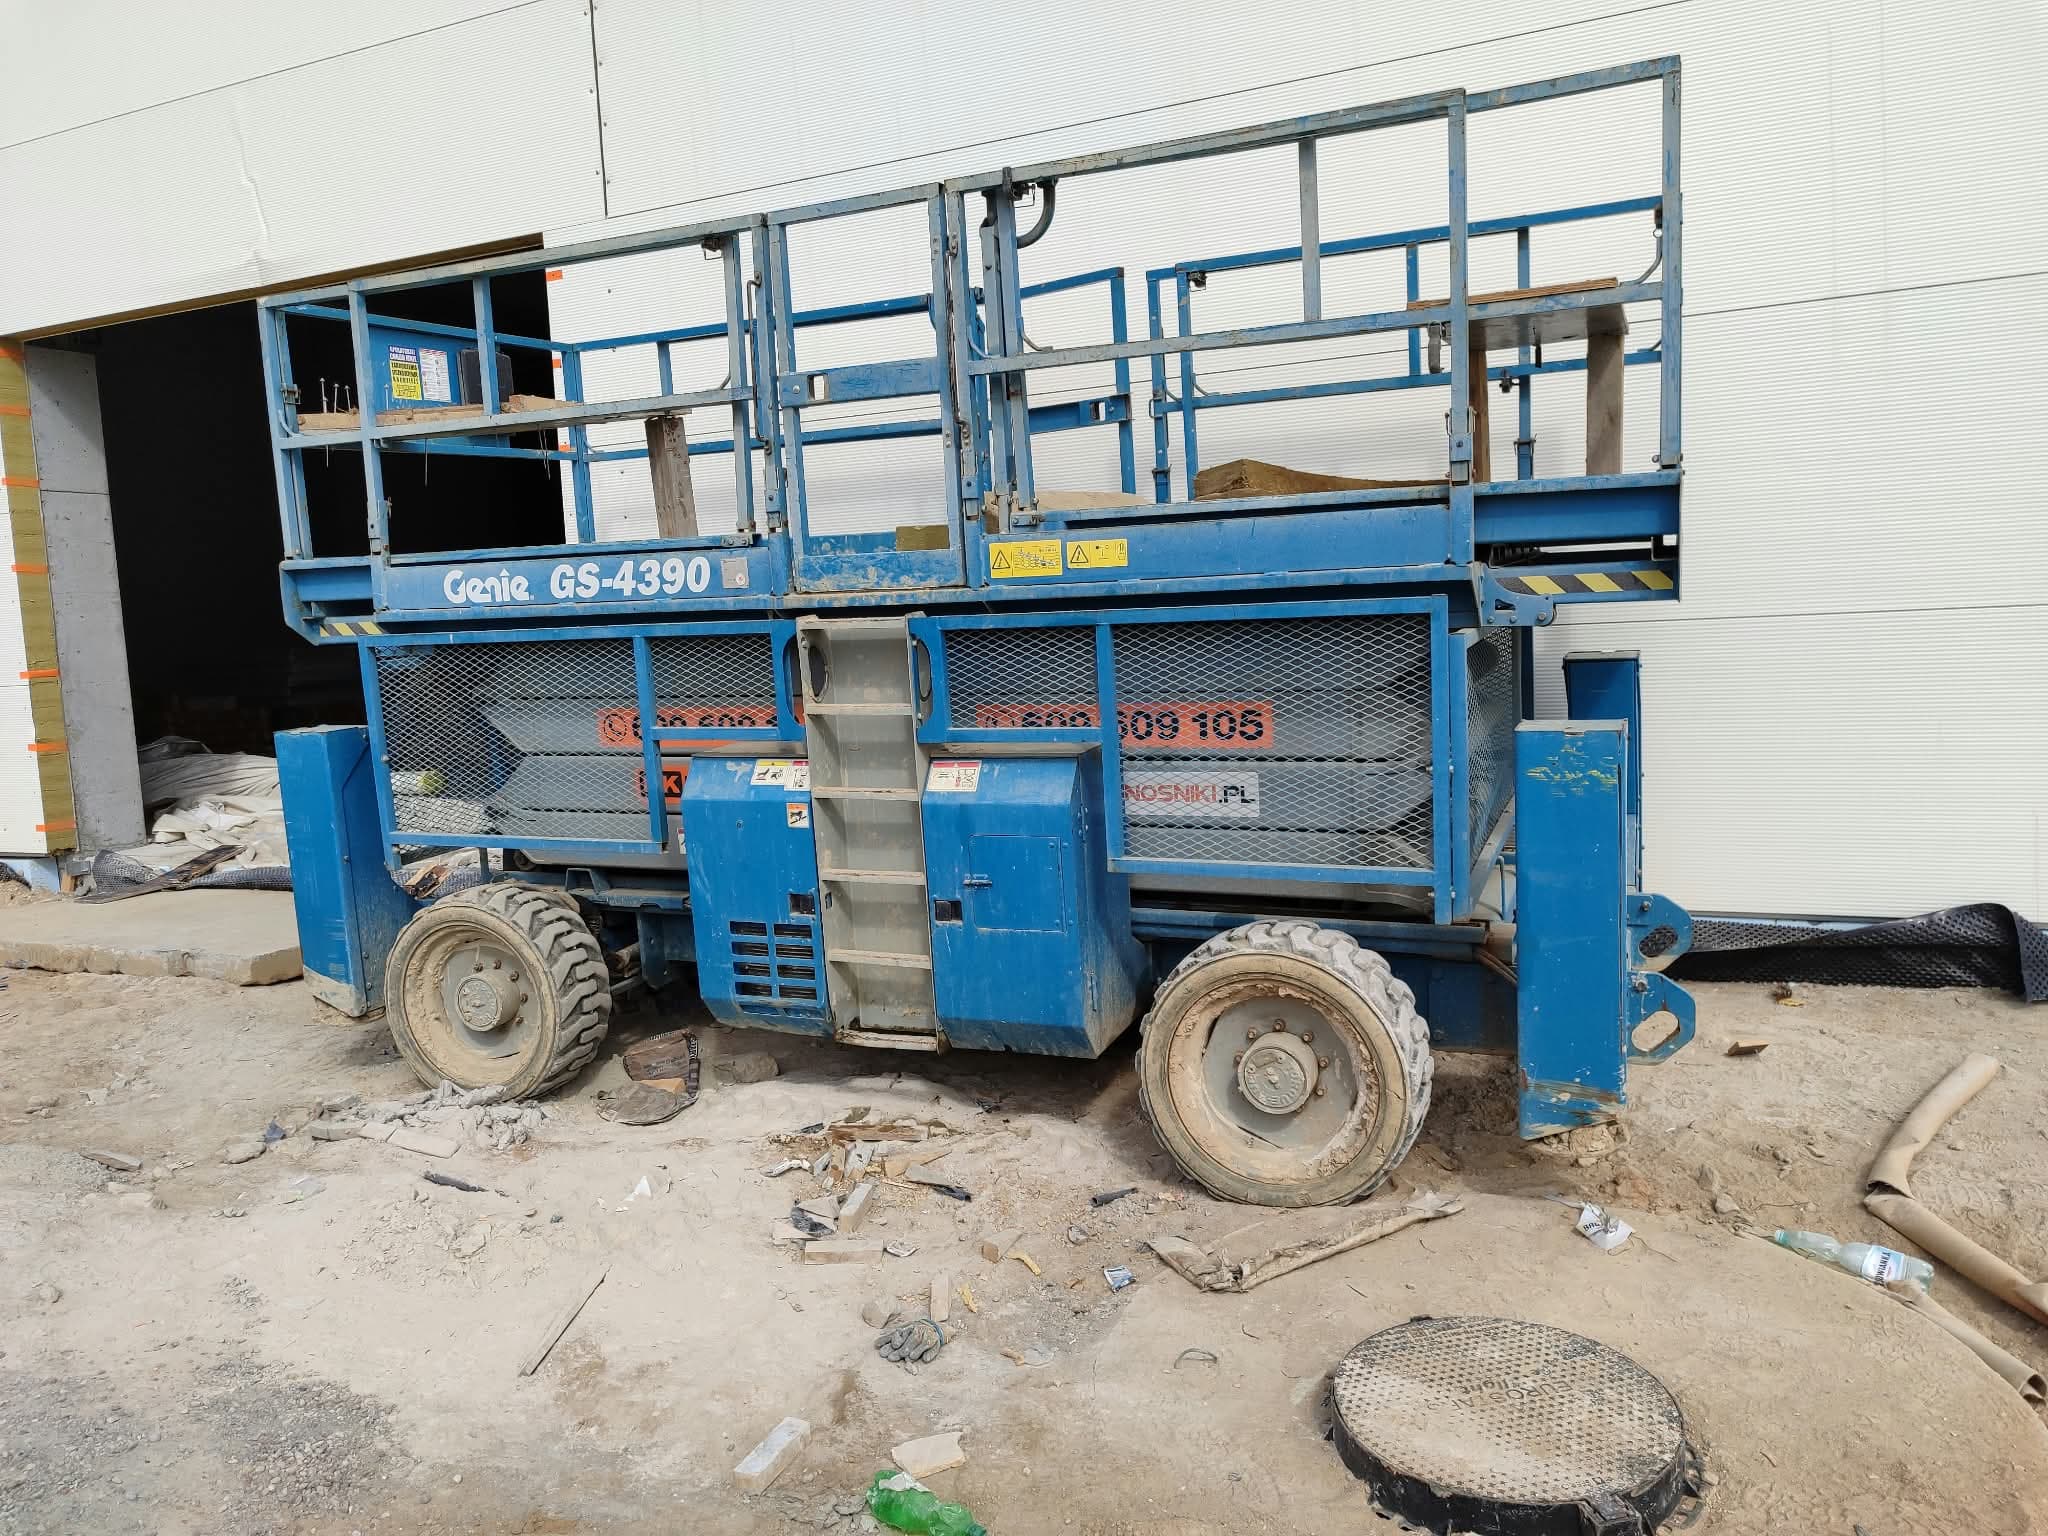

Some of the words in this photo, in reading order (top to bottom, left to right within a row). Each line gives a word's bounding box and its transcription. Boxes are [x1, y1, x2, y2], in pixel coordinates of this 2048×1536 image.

[443, 568, 530, 604] Genie
[550, 556, 711, 599] GS-4390
[1191, 709, 1264, 741] 105
